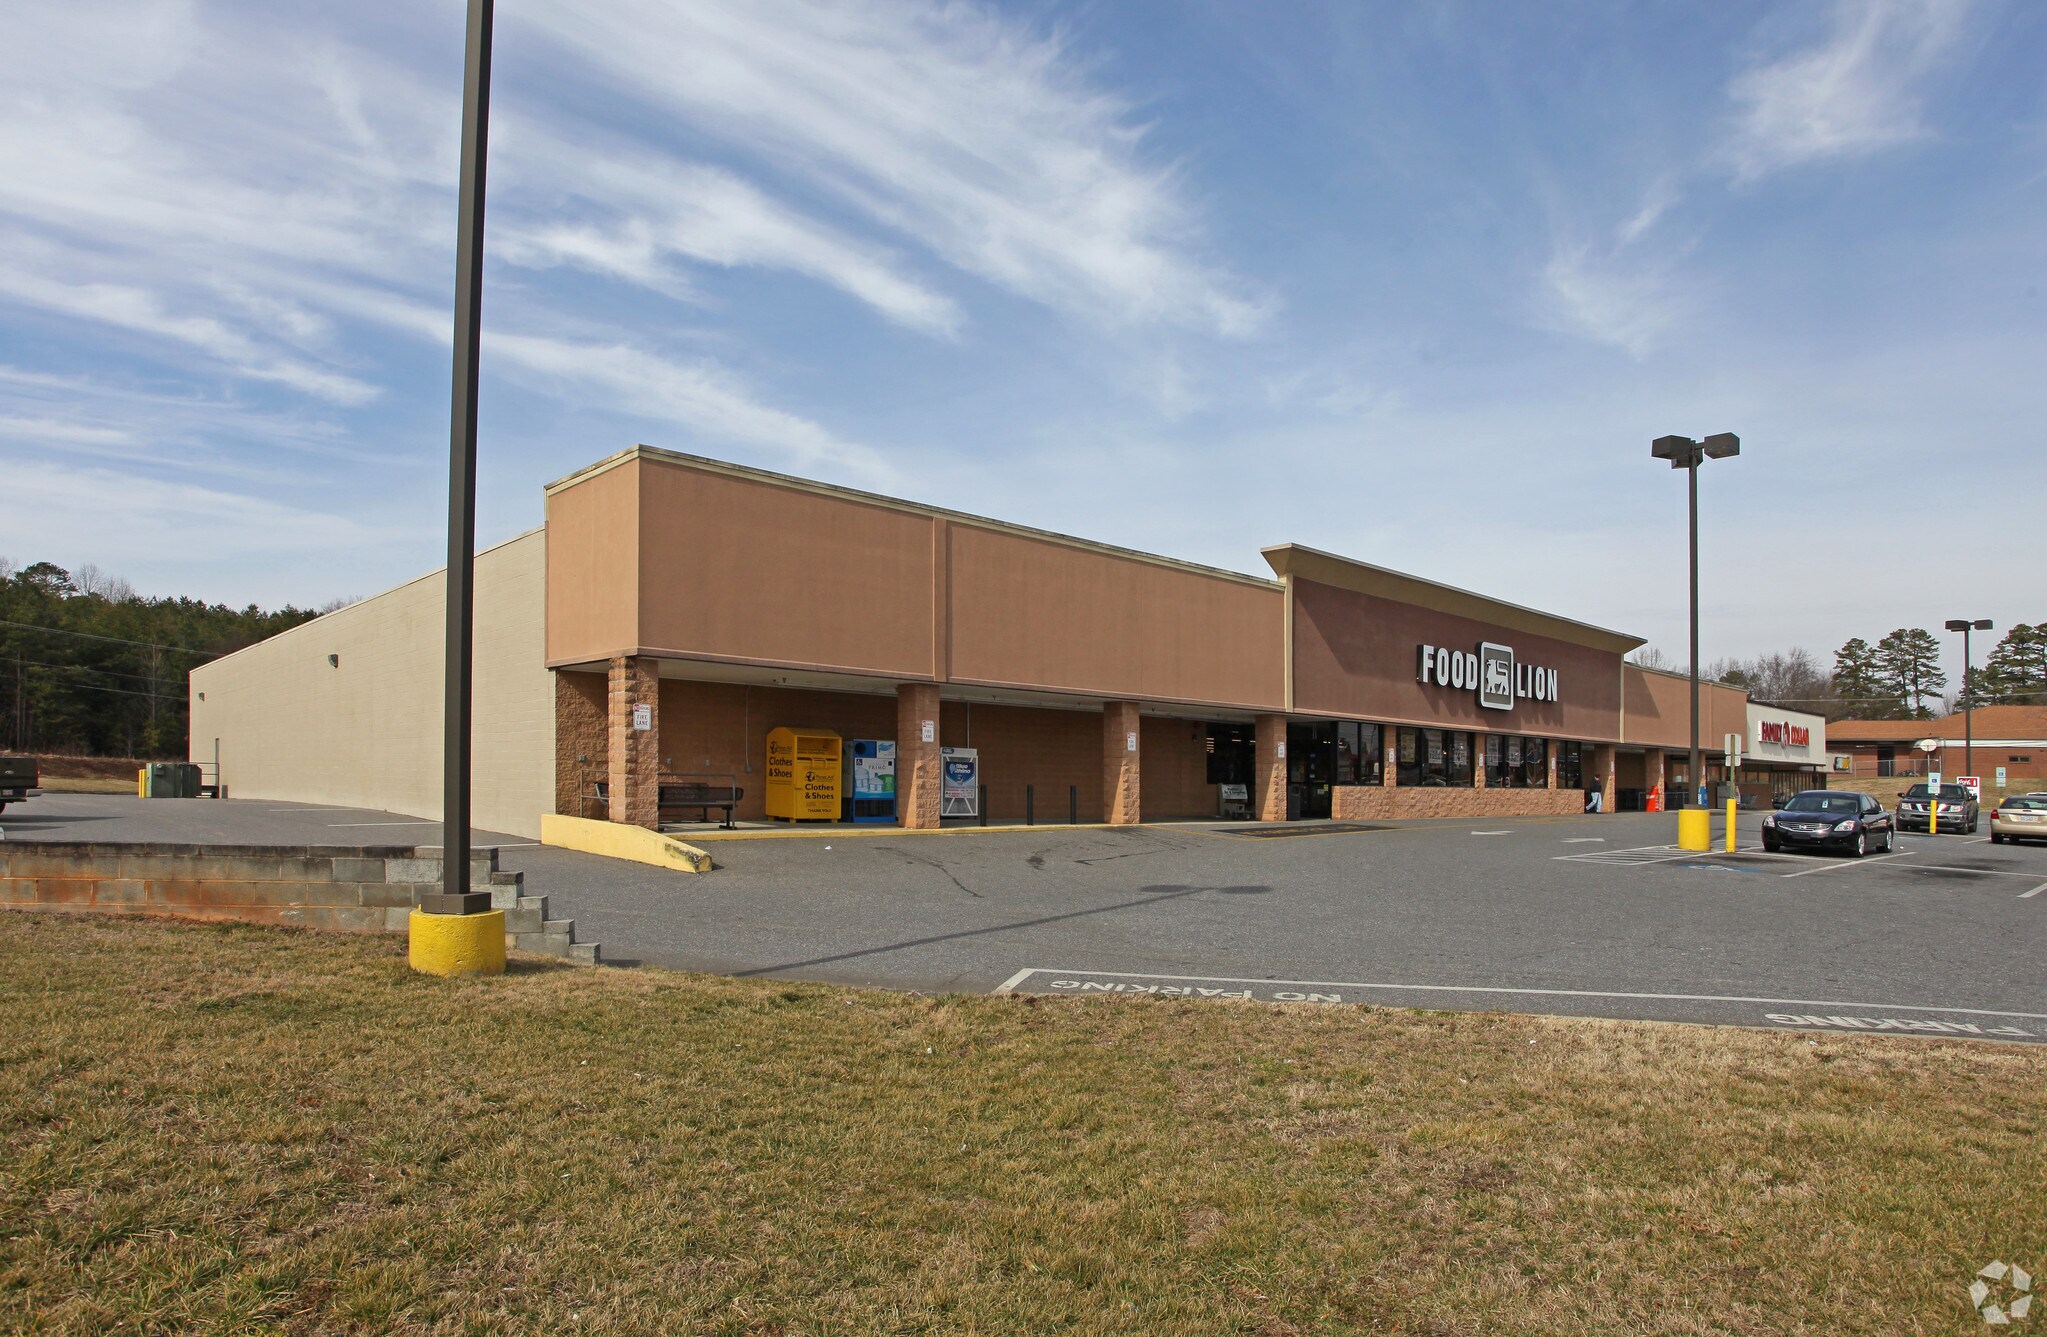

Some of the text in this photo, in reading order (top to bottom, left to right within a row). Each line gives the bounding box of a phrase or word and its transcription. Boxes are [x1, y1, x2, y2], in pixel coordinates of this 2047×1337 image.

[1420, 644, 1558, 702] FOOD LION
[769, 756, 793, 766] Clothes
[804, 783, 834, 791] Clothes
[804, 791, 834, 800] & Shoes
[1050, 980, 1342, 1003] NO PARKING
